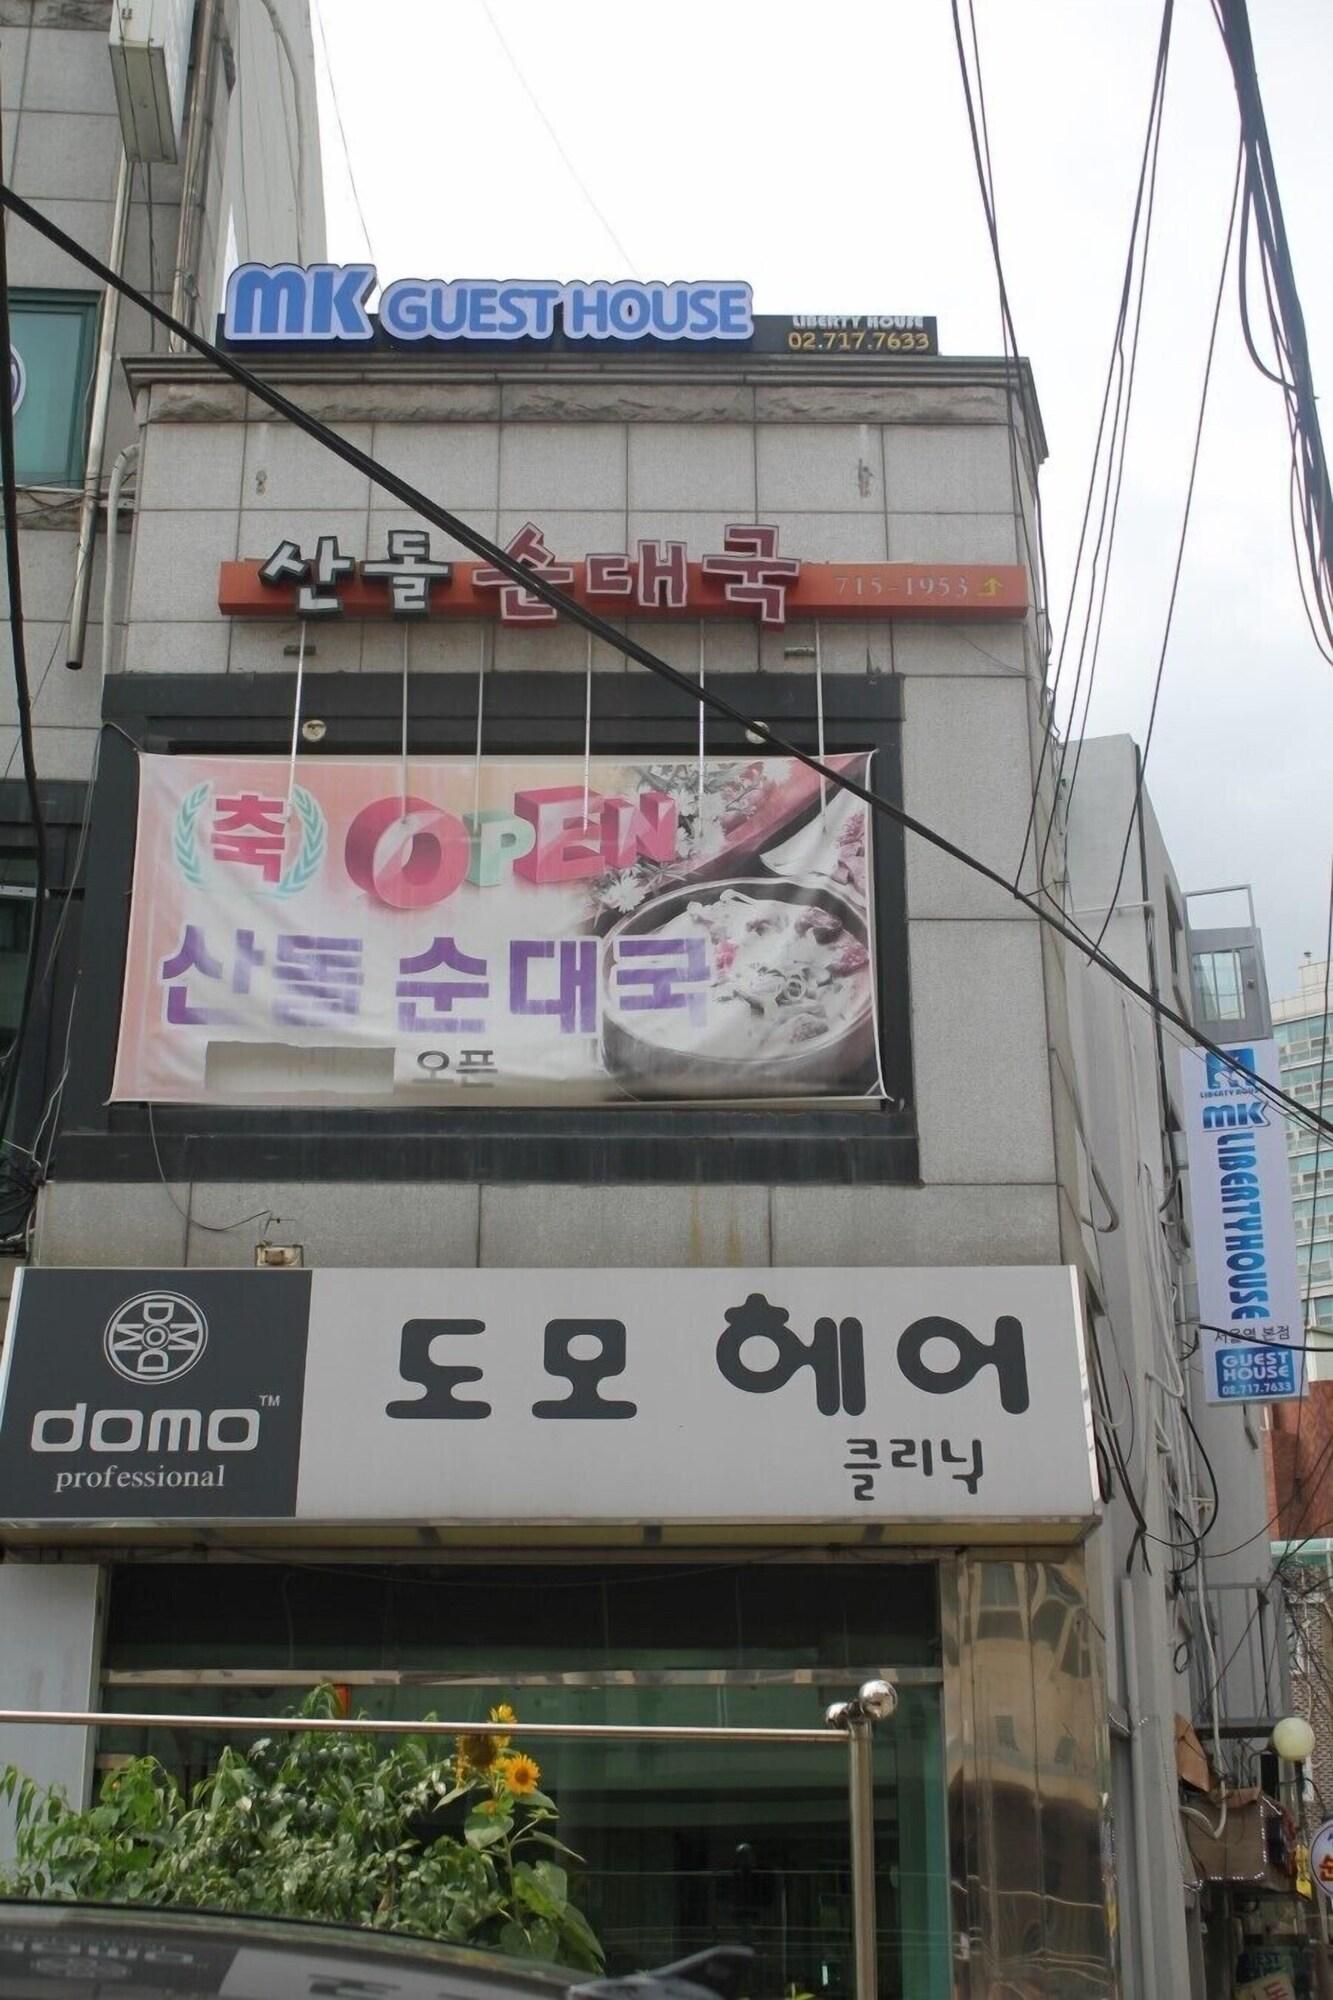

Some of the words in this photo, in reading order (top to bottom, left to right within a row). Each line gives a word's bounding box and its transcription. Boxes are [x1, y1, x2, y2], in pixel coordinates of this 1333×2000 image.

[388, 288, 558, 335] GUEST
[563, 287, 749, 335] HOUSE
[792, 315, 863, 329] LIBERTY
[866, 315, 924, 329] HOUSE
[788, 331, 930, 350] 02.717.7633
[835, 576, 969, 596] 715-1953
[211, 794, 286, 882] 축
[345, 786, 677, 909] OPEN
[412, 1049, 498, 1088] 오픈
[716, 1293, 1030, 1416] 헤어
[1222, 1350, 1290, 1368] GUEST
[1223, 1365, 1290, 1382] HOUSE
[31, 1402, 261, 1452] domo
[54, 1464, 226, 1493] professional
[843, 1438, 984, 1501] 클리닉
